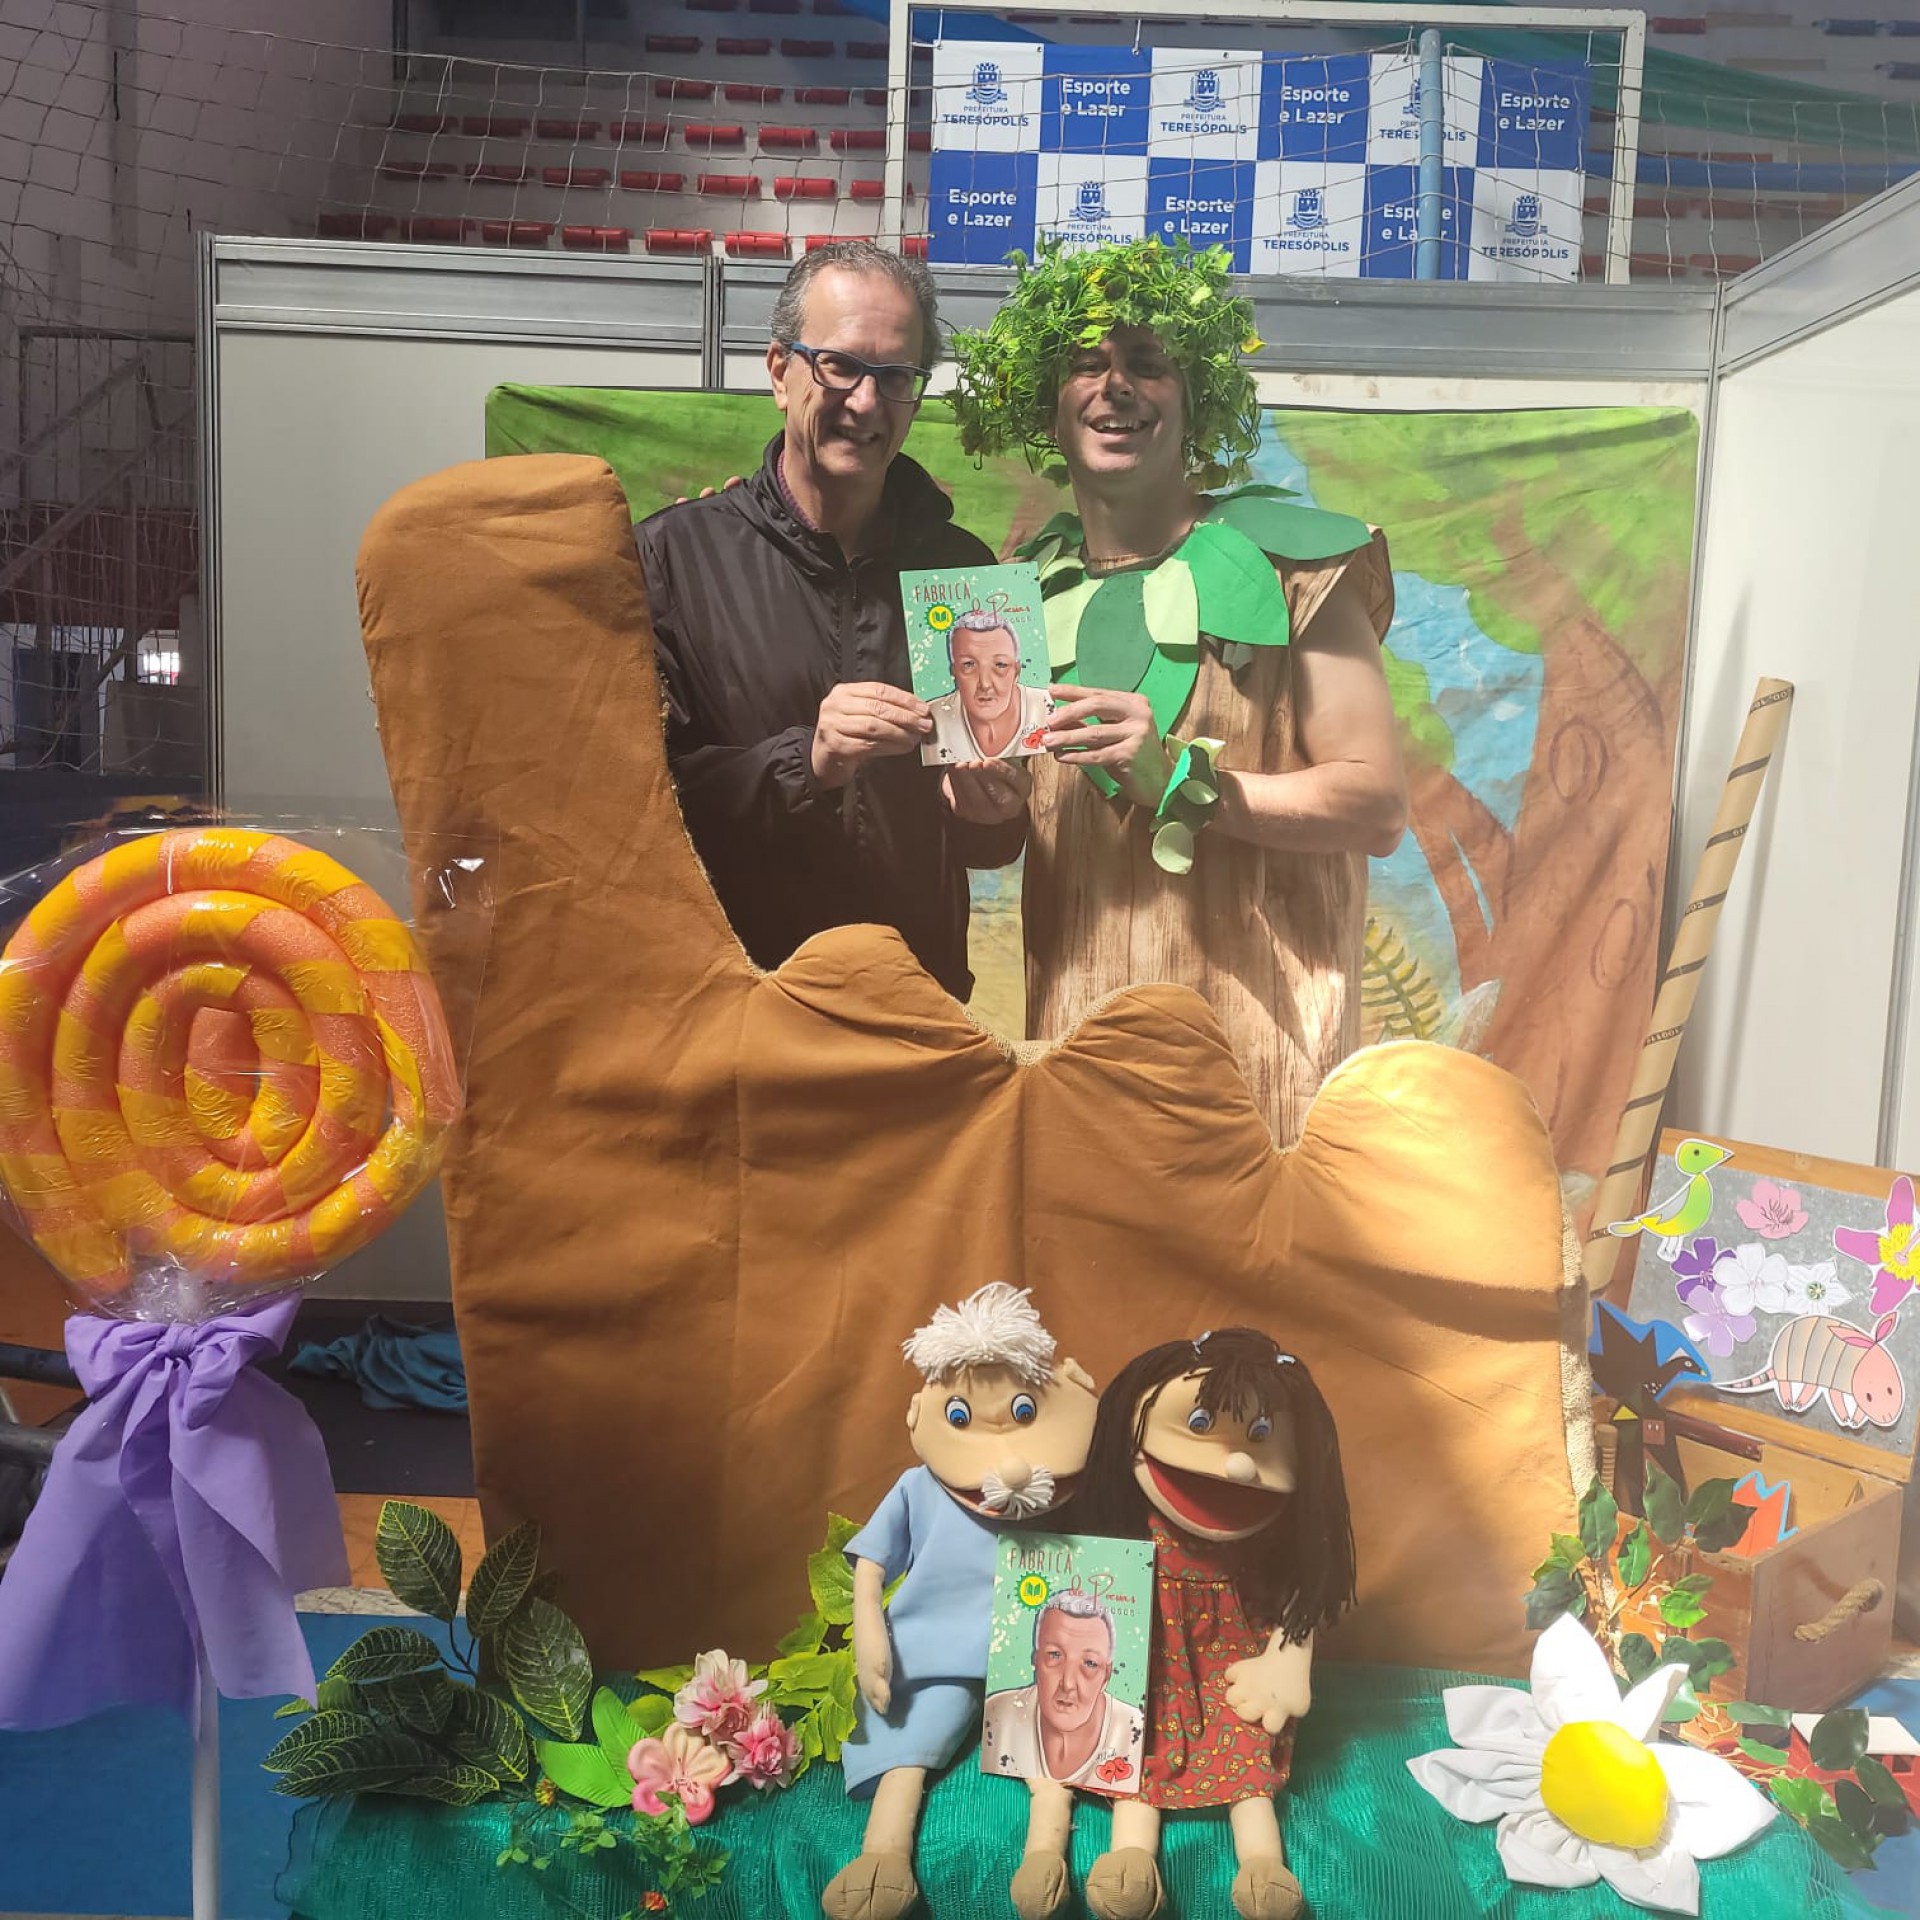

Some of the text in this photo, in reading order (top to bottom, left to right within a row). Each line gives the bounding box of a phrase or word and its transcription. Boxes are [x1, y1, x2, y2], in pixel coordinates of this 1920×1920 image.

[1062, 78, 1131, 96] Esporte
[1281, 86, 1350, 104] Esporte
[1061, 101, 1126, 117] e Lazer
[1501, 93, 1571, 111] Esporte
[942, 113, 1029, 127] TERESÓPOLIS
[1279, 109, 1344, 125] e Lazer
[1499, 116, 1565, 131] e Lazer
[1160, 121, 1247, 134] TERESÓPOLIS
[949, 188, 1017, 207] Esporte
[1166, 196, 1234, 214] Esporte
[947, 211, 1012, 228] e Lazer
[1163, 218, 1228, 235] e Lazer
[1382, 226, 1447, 241] e Lar
[1263, 238, 1350, 252] TERESÓPOLIS
[1481, 245, 1569, 259] TERESÓPOLIS
